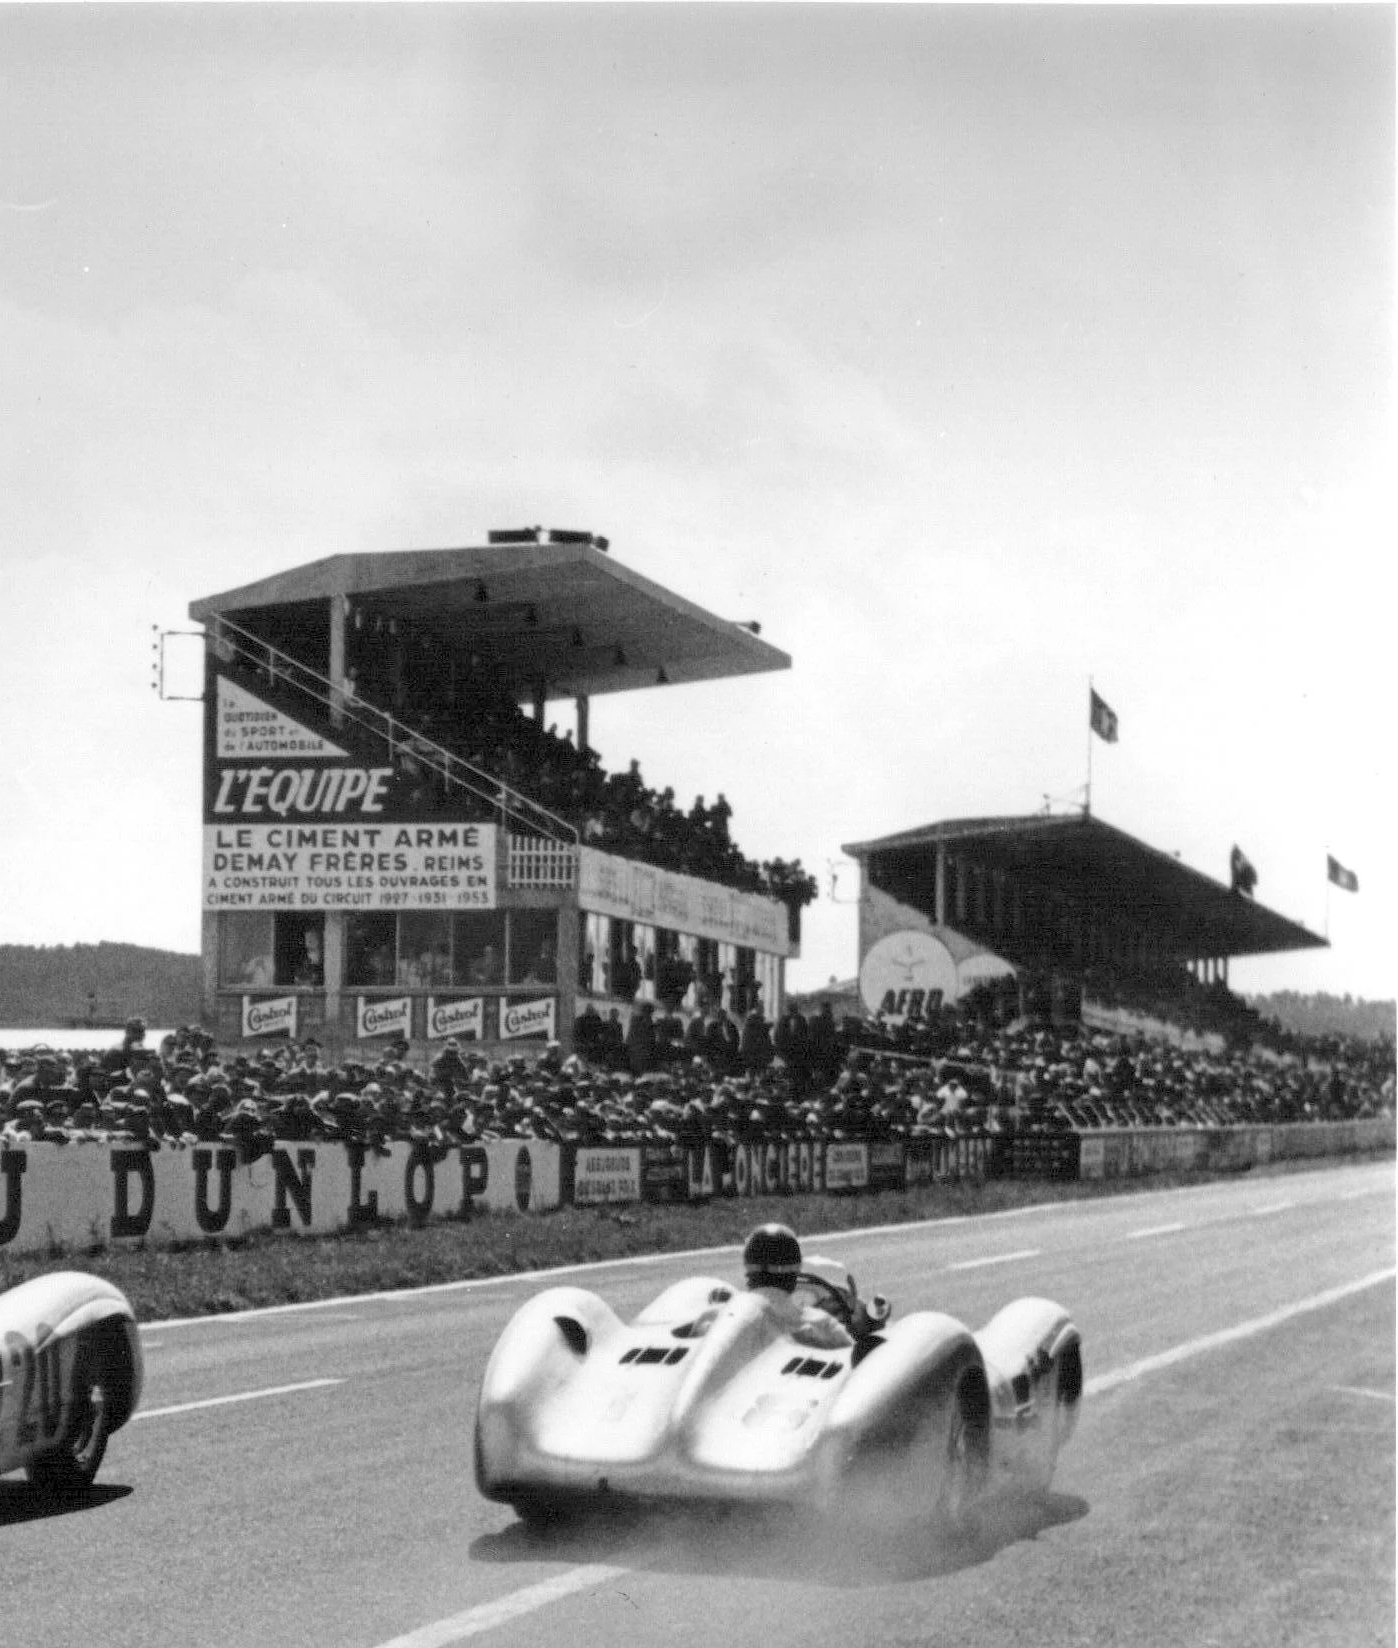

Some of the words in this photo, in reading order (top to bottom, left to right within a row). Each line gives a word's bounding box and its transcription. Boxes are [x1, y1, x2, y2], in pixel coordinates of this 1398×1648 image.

[223, 711, 278, 724] QUOTIDIEN
[241, 725, 285, 738] SPORT
[213, 766, 394, 817] L'ÉQUIPE
[216, 829, 252, 848] LE
[266, 829, 381, 849] CIMENT
[394, 826, 479, 849] ARMÉ
[213, 852, 298, 872] DEMAY
[424, 855, 484, 872] REIMS
[223, 876, 299, 888] CONSTRUIT
[306, 876, 342, 888] TOUS
[347, 875, 374, 888] LES
[380, 875, 460, 888] OUVRAGES
[467, 875, 488, 888] EN
[206, 892, 253, 905] CIMENT
[301, 892, 318, 905] DU
[323, 891, 372, 905] CIRCUIT
[247, 1002, 292, 1032] Castrol
[362, 1002, 408, 1033] Castrol
[432, 1002, 480, 1034] Castrol
[504, 1002, 552, 1033] Castrol
[688, 1146, 715, 1197] LA
[109, 1144, 489, 1238] DUNLOP
